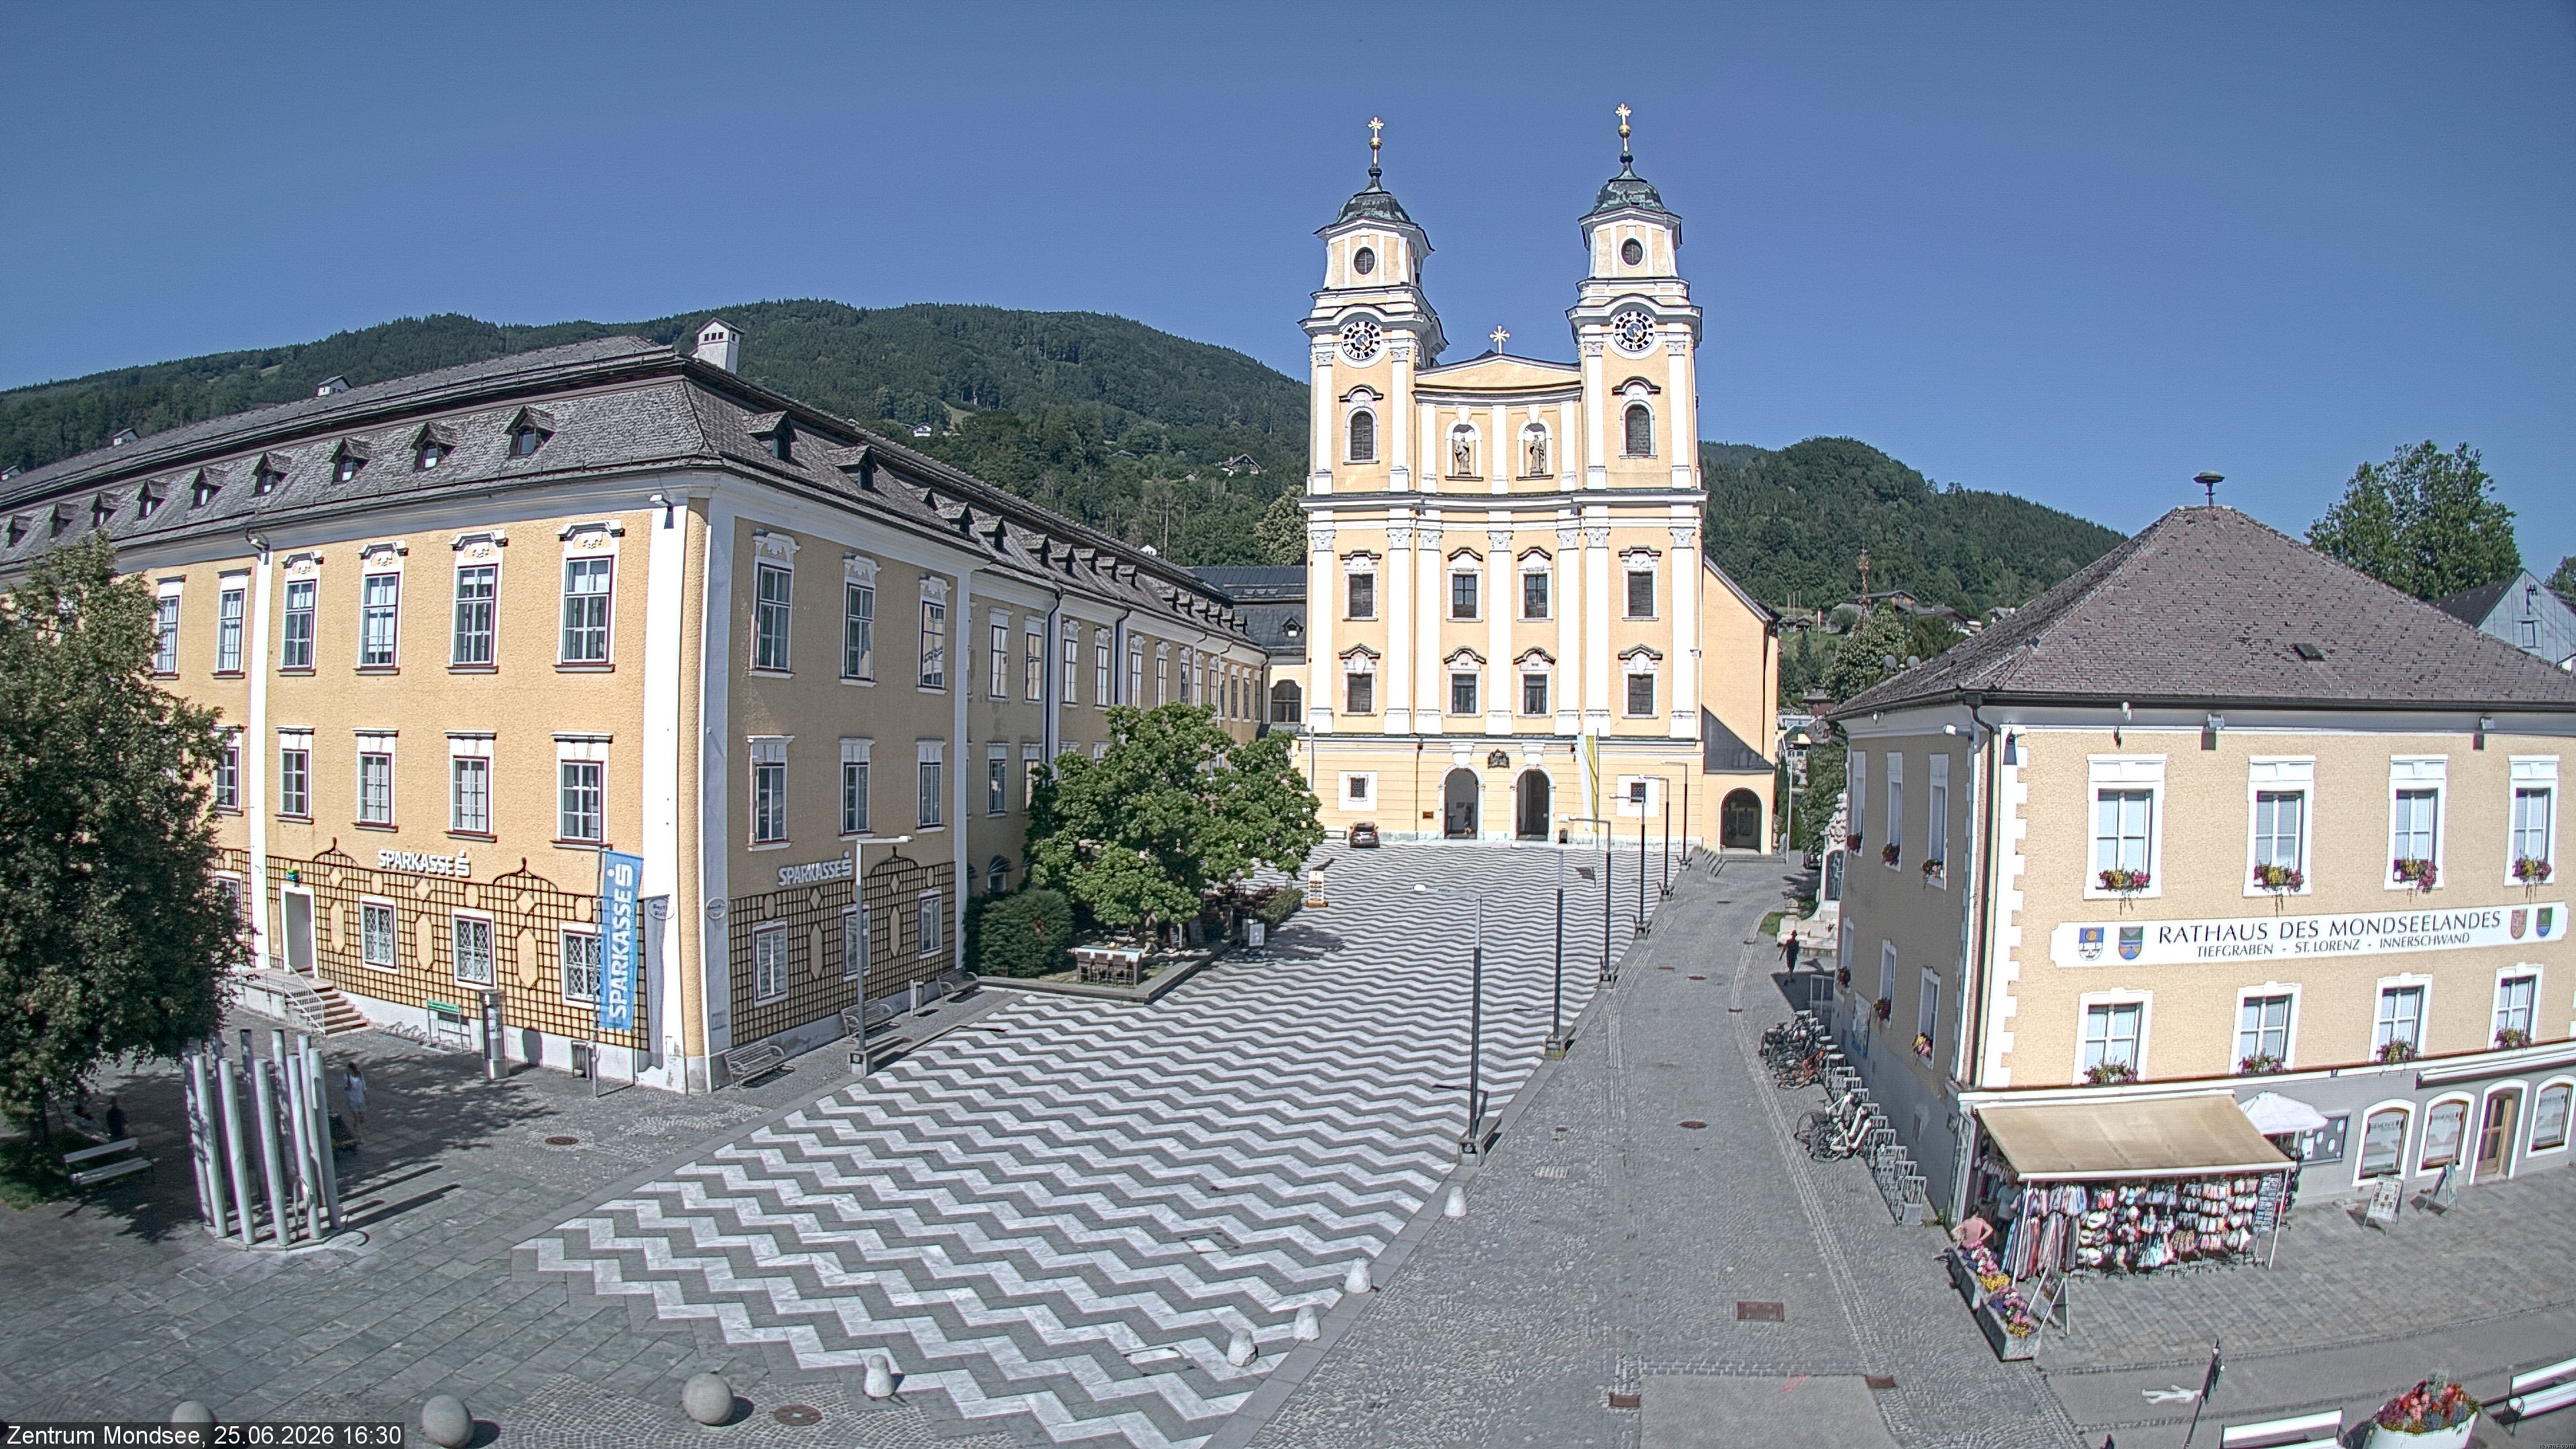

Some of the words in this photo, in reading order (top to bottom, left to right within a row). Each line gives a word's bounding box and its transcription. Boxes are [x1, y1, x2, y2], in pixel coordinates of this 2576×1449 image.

[378, 849, 455, 875] SPARKASSE
[778, 861, 842, 886] SPARKASSE
[2159, 922, 2268, 944] RATHAUS
[2279, 920, 2318, 939] DES
[2329, 910, 2501, 937] MONDSEELANDES
[609, 889, 631, 1018] SPARKASSE
[2196, 943, 2274, 958] TIEFGRABEN
[2294, 941, 2310, 953] ST.
[2313, 939, 2361, 953] LORENZ
[2379, 932, 2471, 949] INNERSCHWAND
